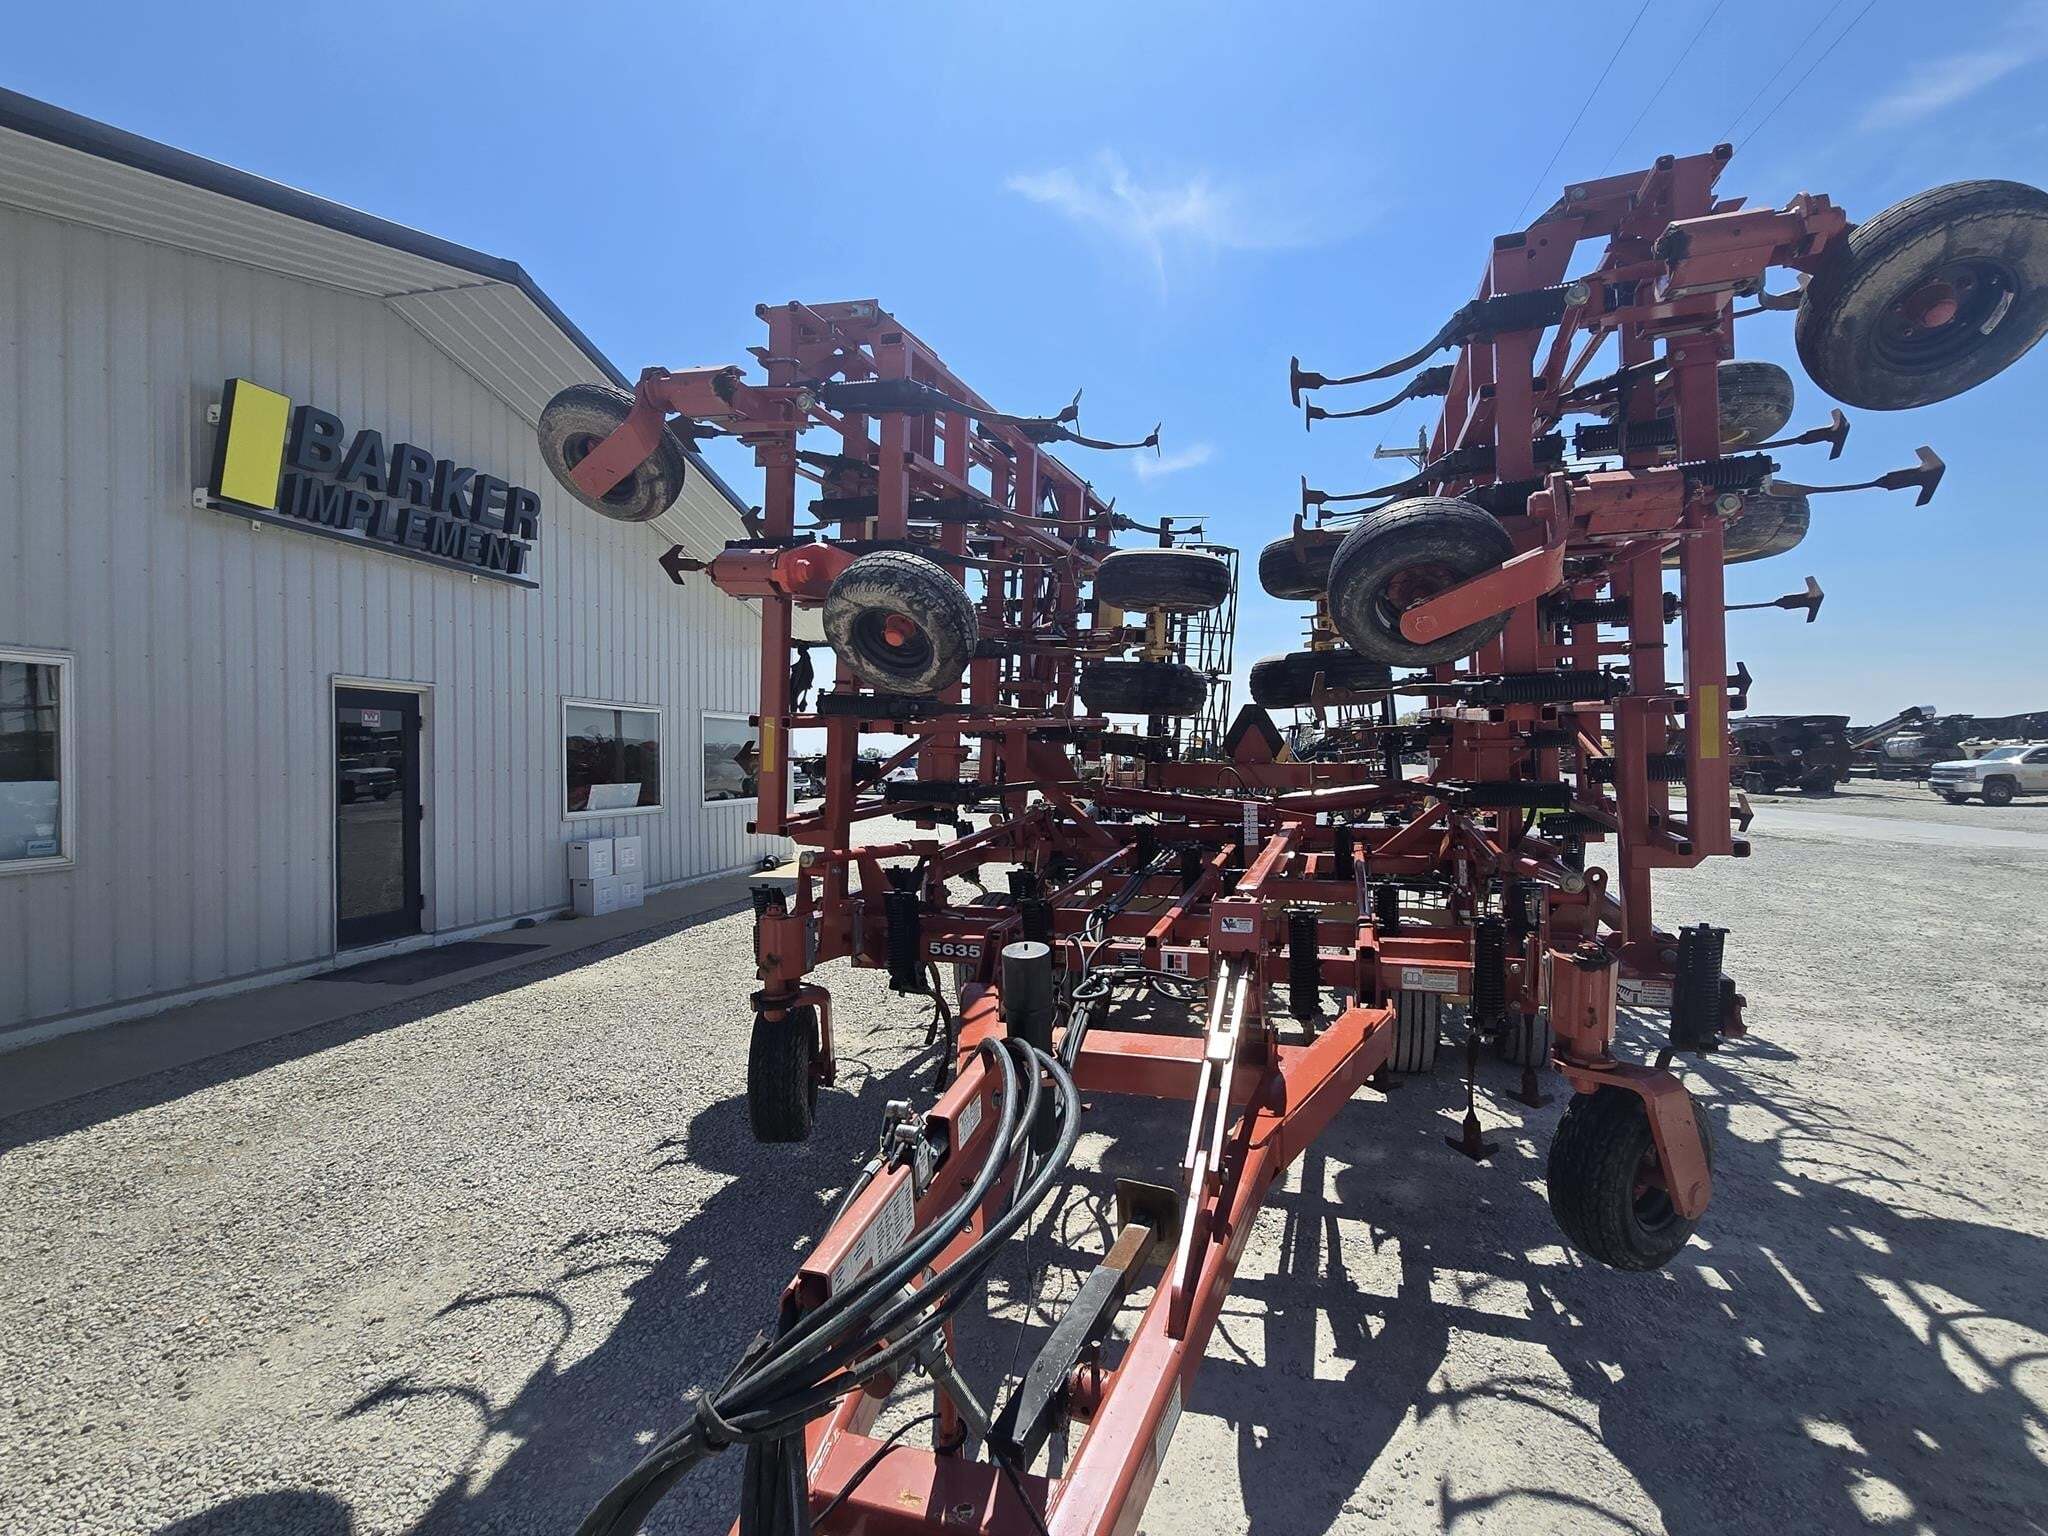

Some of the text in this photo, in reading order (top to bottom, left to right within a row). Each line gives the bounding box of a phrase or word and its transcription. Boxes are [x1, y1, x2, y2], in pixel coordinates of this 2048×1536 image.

[279, 472, 532, 574] IMPLEMENT
[287, 405, 542, 541] BARKER
[929, 942, 981, 958] 5635
